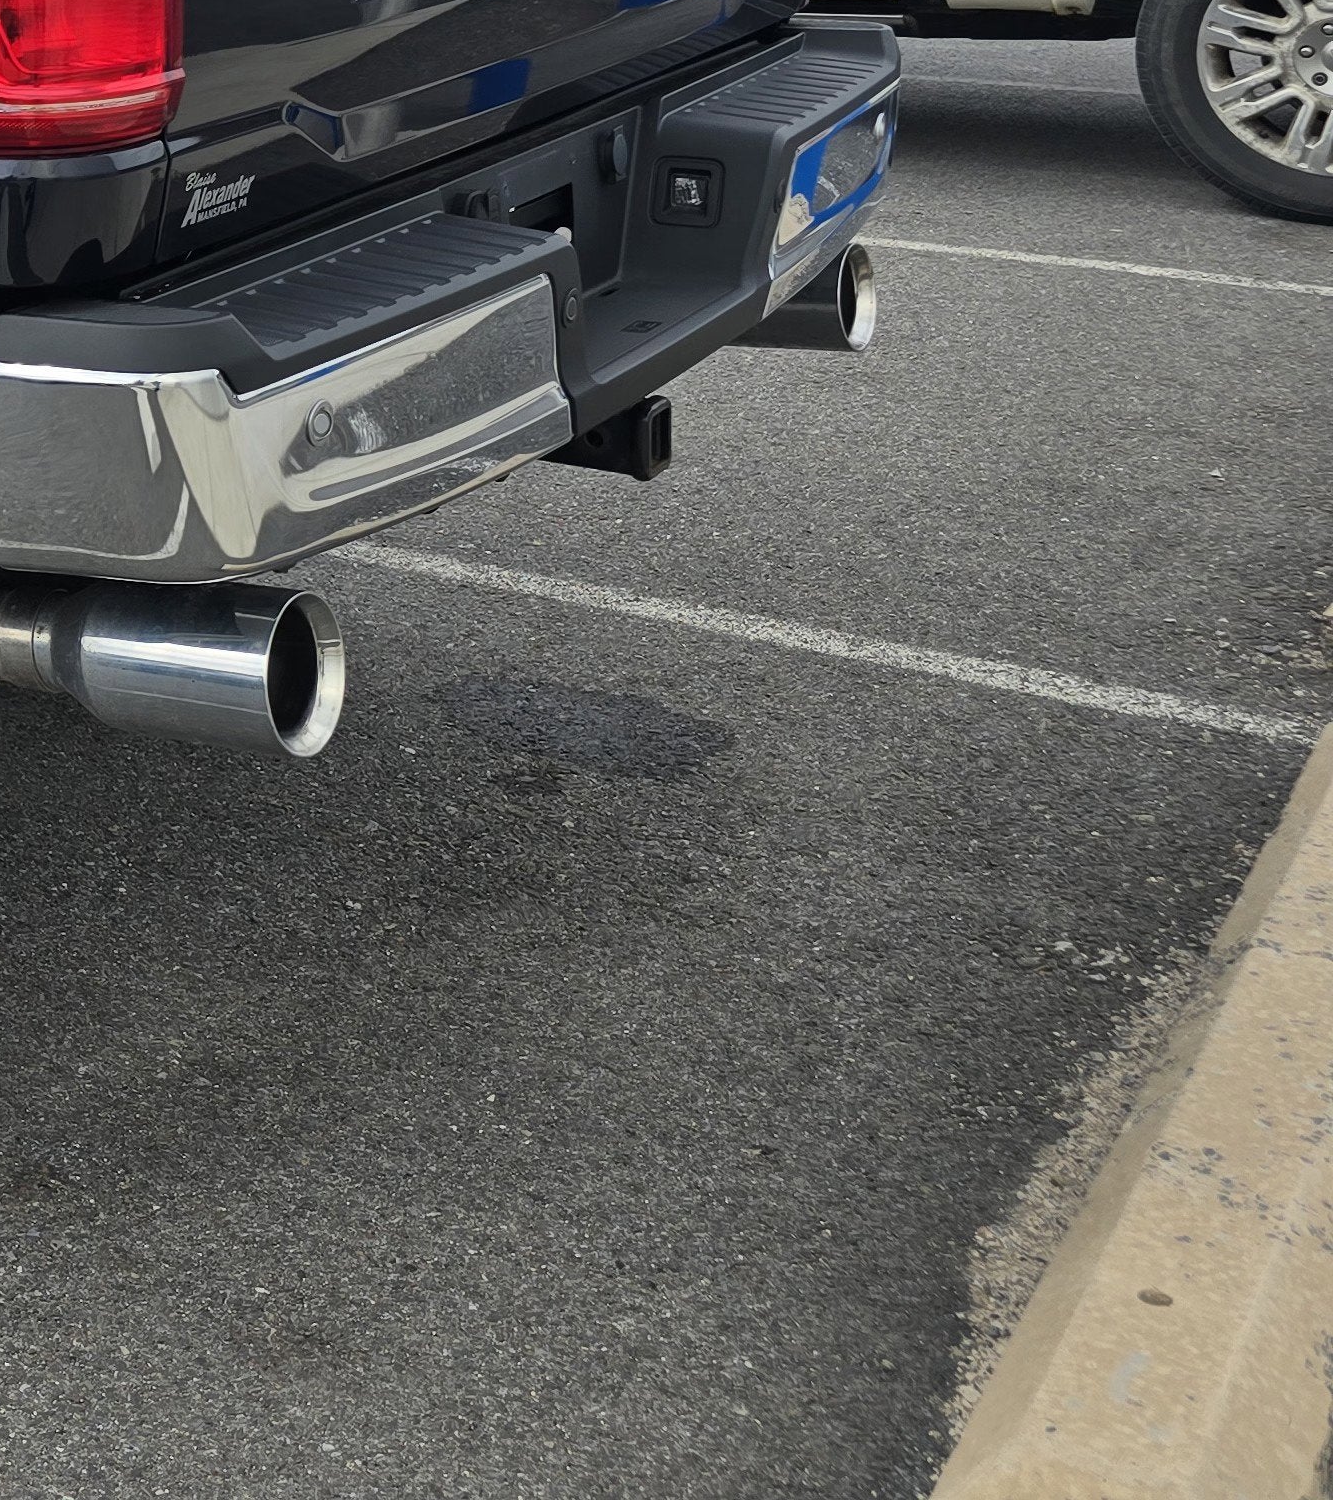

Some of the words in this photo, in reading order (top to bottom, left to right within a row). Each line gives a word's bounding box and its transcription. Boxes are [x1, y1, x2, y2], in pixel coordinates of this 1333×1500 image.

[185, 172, 216, 191] Blaise
[180, 174, 256, 228] Alexander
[197, 201, 237, 222] MANSFIELD,
[238, 197, 247, 208] PA
